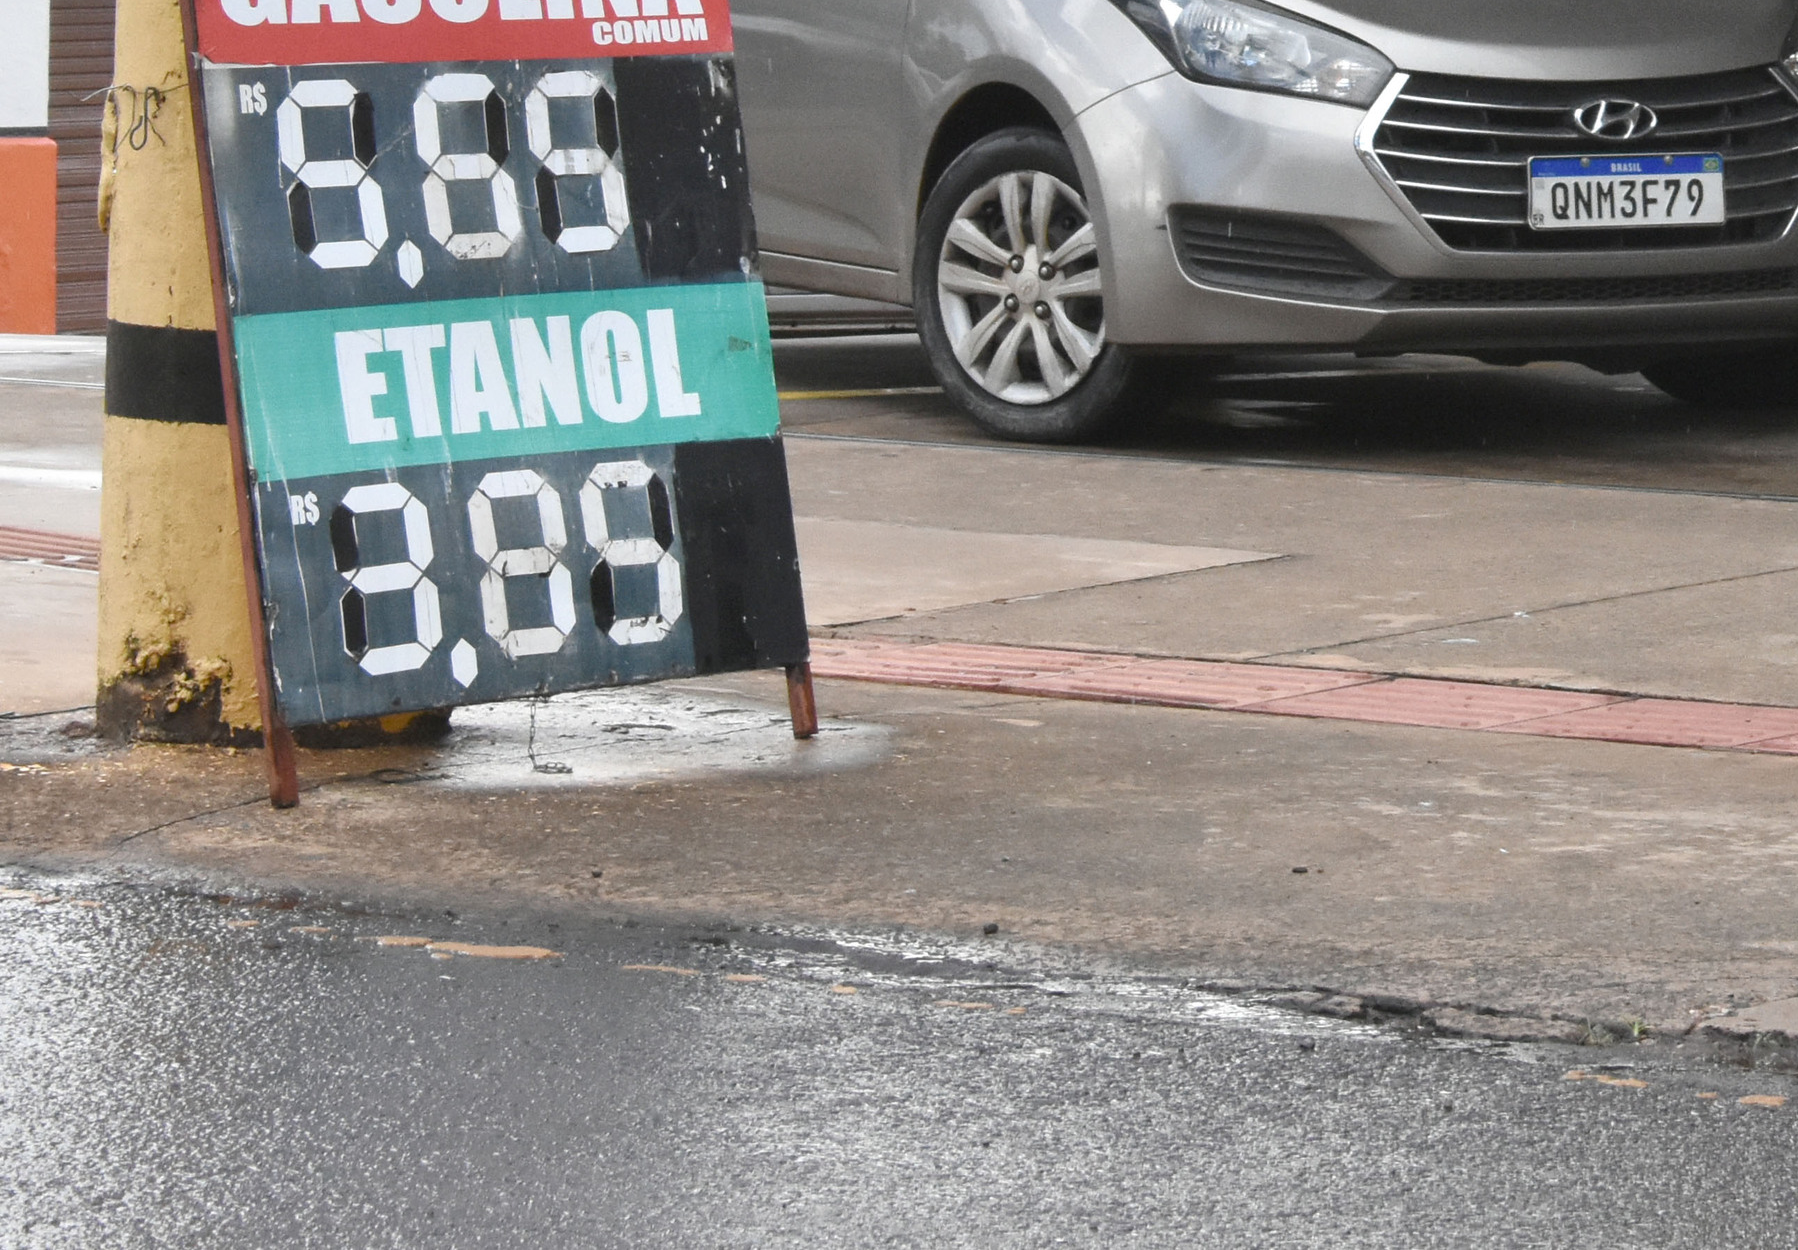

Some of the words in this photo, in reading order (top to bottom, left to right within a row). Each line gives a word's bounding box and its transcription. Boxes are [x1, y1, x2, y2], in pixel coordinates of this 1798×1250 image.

[592, 17, 708, 45] COMUM
[241, 82, 267, 115] R$
[1611, 162, 1641, 173] BRASIL
[1551, 178, 1704, 220] QNM3F79
[334, 308, 701, 444] ETANOL
[291, 492, 319, 525] R$
